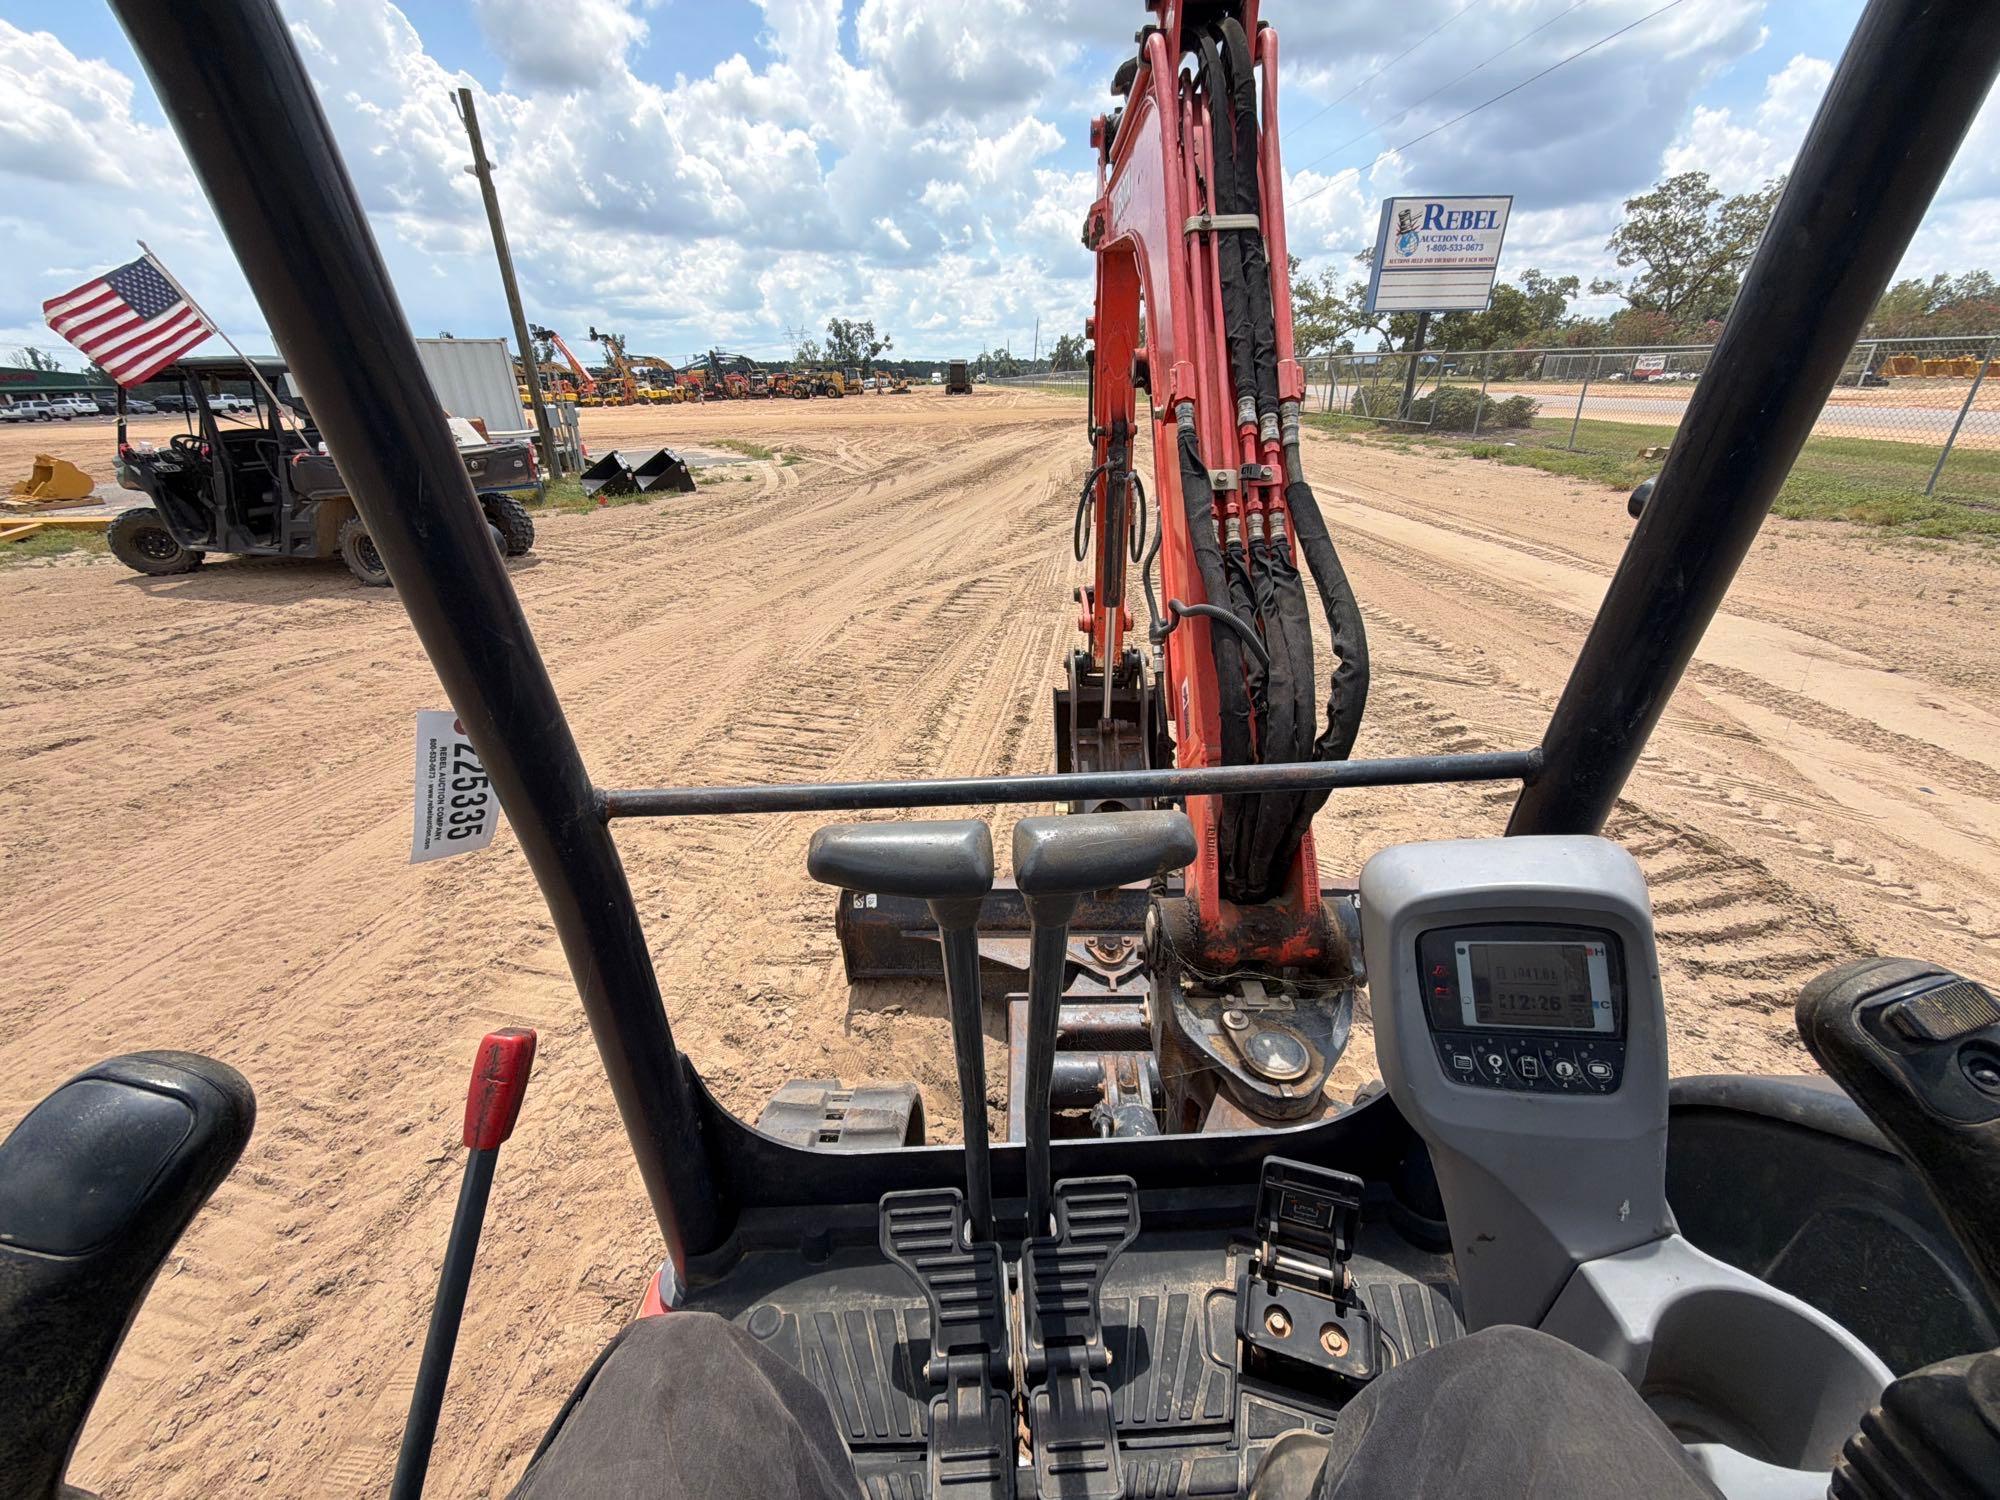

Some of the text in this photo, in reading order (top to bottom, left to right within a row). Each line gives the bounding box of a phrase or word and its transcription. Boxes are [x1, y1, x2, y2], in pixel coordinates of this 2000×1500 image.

[1421, 203, 1500, 230] REBEL
[1420, 235, 1458, 243] AUCTION
[1426, 243, 1484, 252] 1-800-533-0673
[424, 738, 437, 850] 800-533-0673 www.rebelauction.com
[434, 746, 447, 841] REBEL AUCTION COMPANY
[1594, 947, 1605, 956] H
[1600, 1000, 1610, 1009] C
